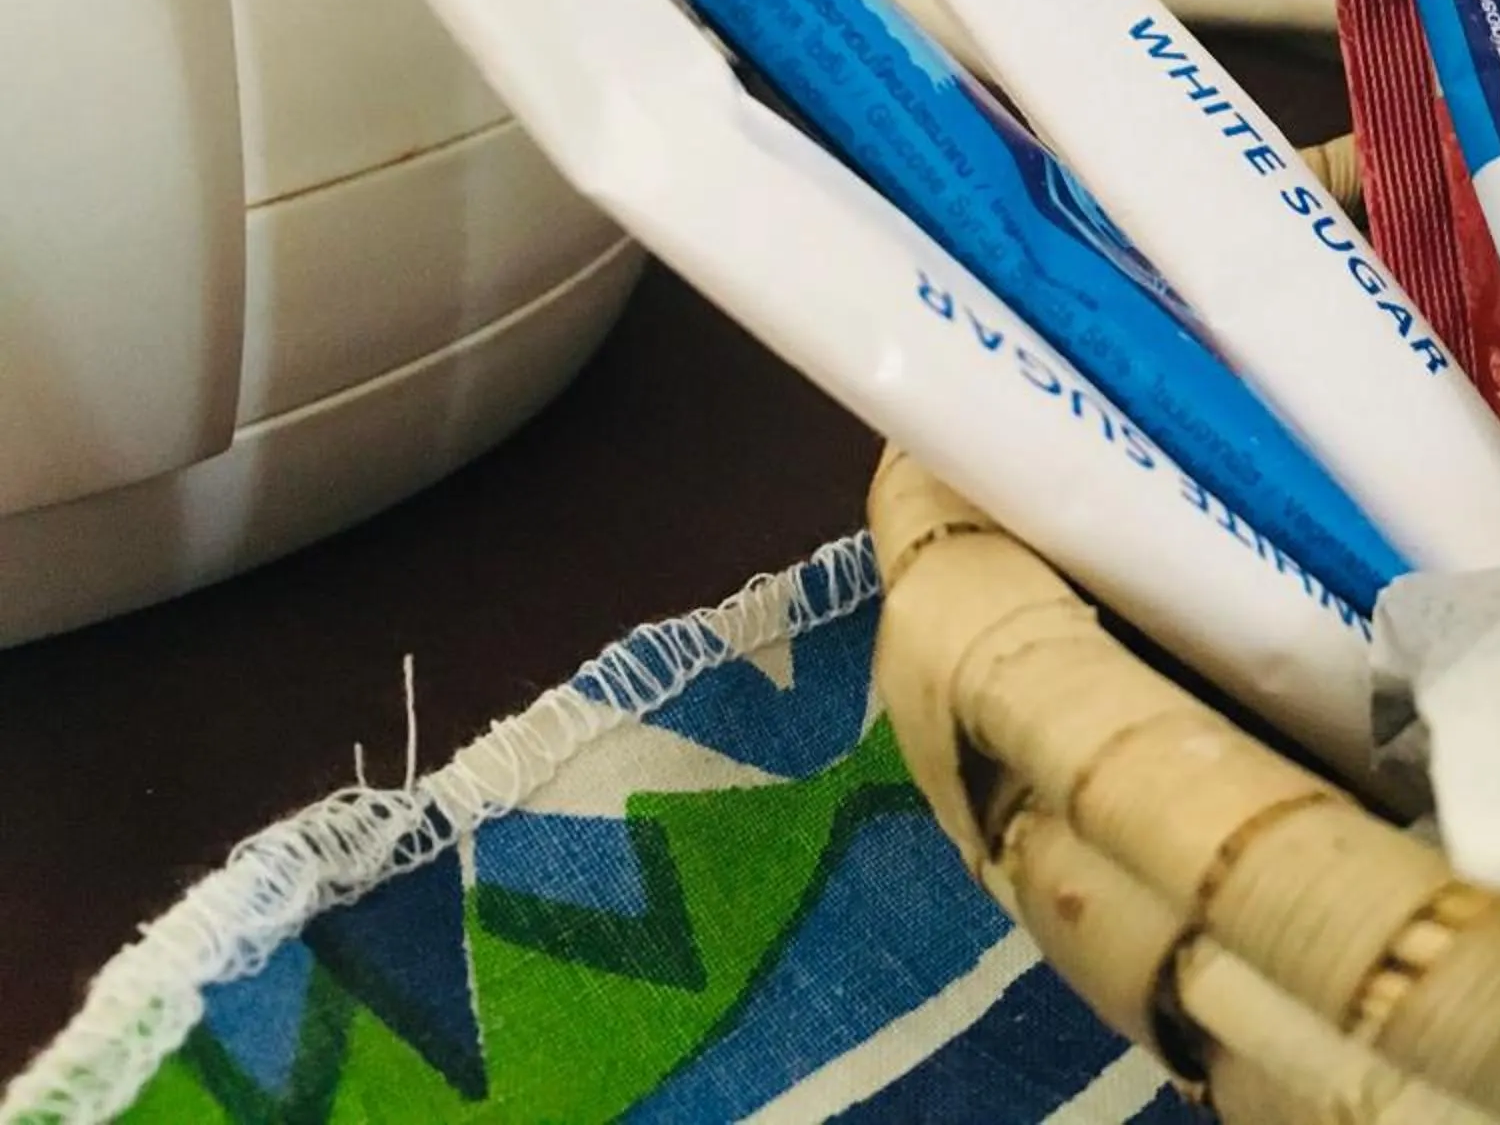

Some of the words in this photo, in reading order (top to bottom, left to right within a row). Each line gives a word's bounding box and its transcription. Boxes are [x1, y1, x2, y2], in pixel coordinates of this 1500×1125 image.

[1128, 16, 1286, 177] WHITE
[1282, 185, 1448, 376] SUGAR
[915, 271, 1155, 470] SUGAR
